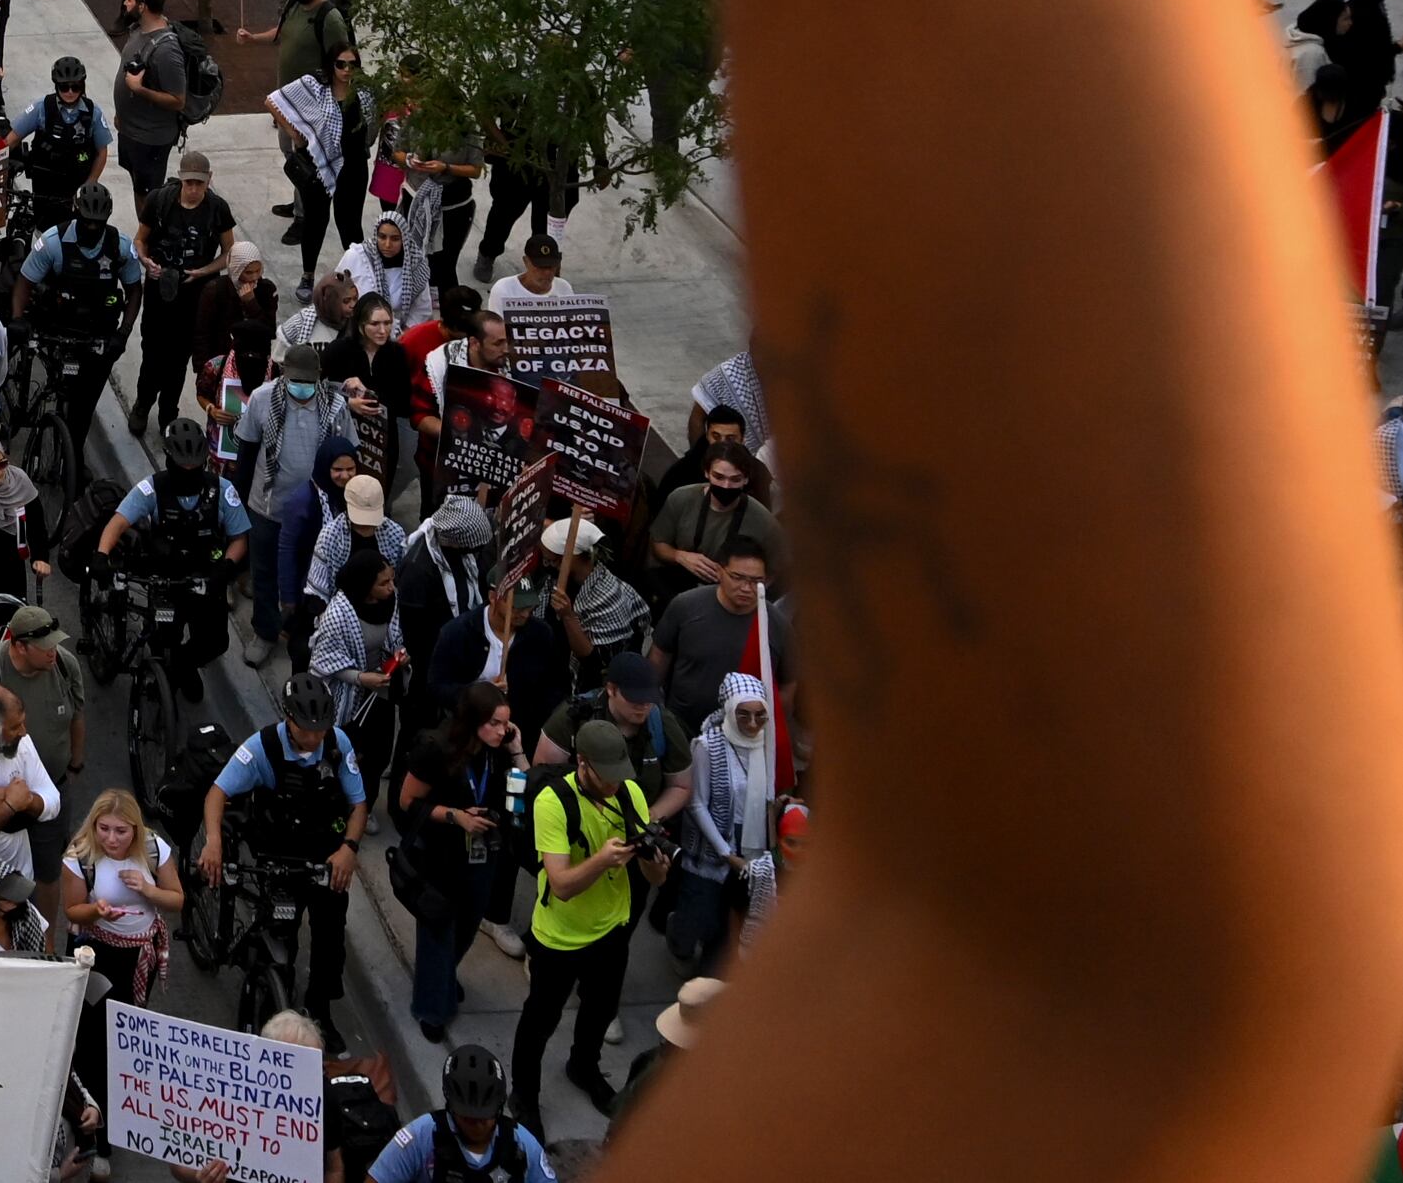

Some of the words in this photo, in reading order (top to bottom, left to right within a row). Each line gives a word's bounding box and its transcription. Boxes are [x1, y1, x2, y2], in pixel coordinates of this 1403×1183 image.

[511, 315, 567, 324] GENOCIDE
[570, 314, 601, 322] JOE'S
[512, 326, 605, 341] LEGACY:
[514, 346, 541, 355] THE
[545, 345, 607, 355] BUTCHER
[516, 360, 544, 372] OF
[551, 358, 610, 372] GAZA
[116, 1012, 159, 1038] SOME
[168, 1025, 250, 1061] ISRAELIS
[259, 1049, 294, 1068] ARE
[118, 1032, 181, 1064] DRUNK
[185, 1055, 200, 1070] ON
[201, 1057, 225, 1075] THE
[230, 1062, 292, 1090] BLOOD
[119, 1074, 151, 1097] THE
[161, 1085, 192, 1111] U.S.
[199, 1096, 264, 1129] MUST
[276, 1117, 318, 1142] END
[134, 1058, 152, 1075] OF
[160, 1064, 321, 1123] PALESTINIANS!
[121, 1096, 159, 1121] ALL
[162, 1109, 250, 1146] SUPPORT
[260, 1136, 281, 1155] TO
[127, 1130, 153, 1154] NO
